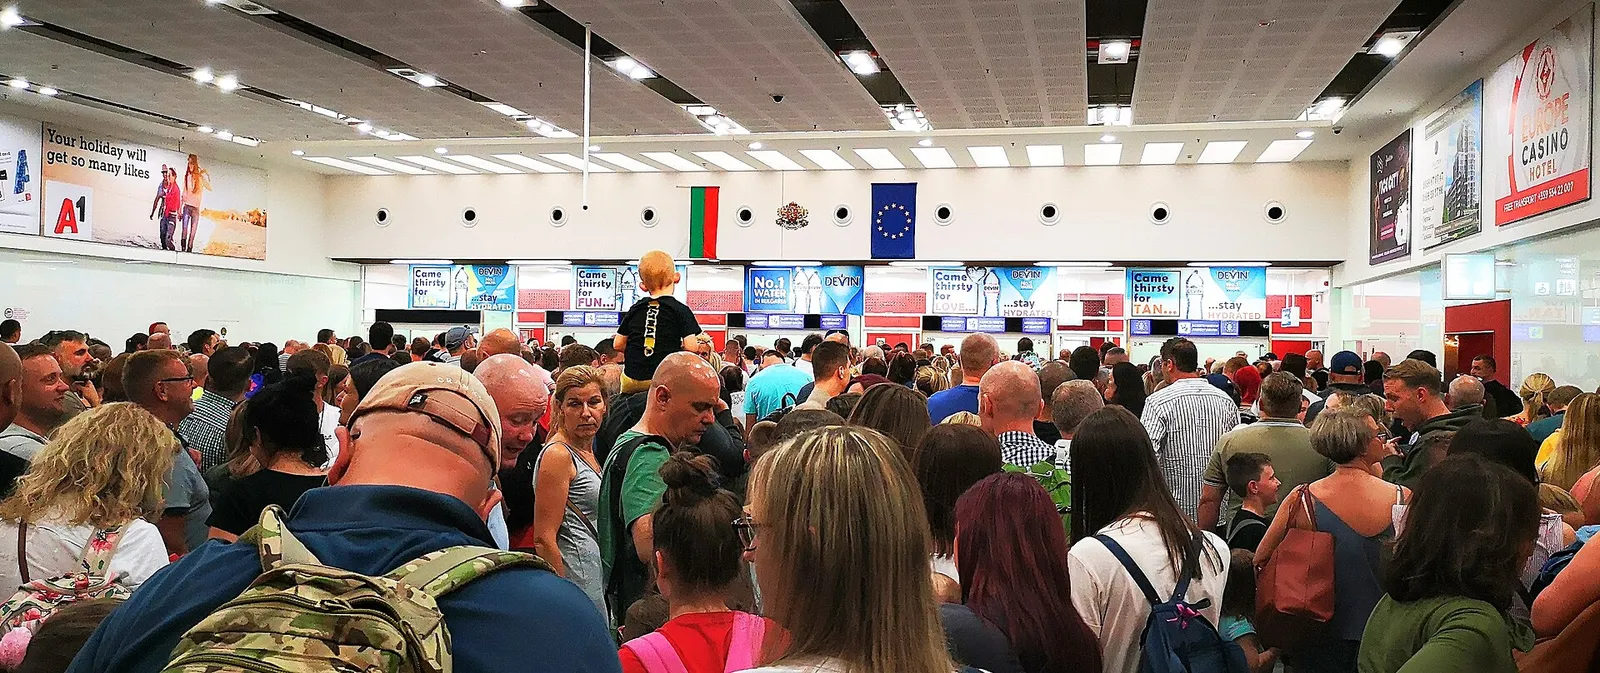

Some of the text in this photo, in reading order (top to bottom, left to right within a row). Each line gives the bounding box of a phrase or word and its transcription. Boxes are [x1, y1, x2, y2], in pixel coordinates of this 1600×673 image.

[1522, 93, 1570, 143] EUROPE
[47, 128, 147, 162] Your holiday will
[1522, 128, 1568, 166] CASINO
[47, 150, 150, 179] get so many likes
[1529, 159, 1557, 181] HOTEL
[54, 195, 86, 234] A1
[415, 269, 442, 278] Came
[578, 270, 607, 279] Came
[935, 271, 967, 282] Came
[1012, 269, 1041, 279] DEVIN
[1134, 273, 1169, 283] Came
[1217, 270, 1249, 280] DEVIN
[415, 278, 446, 288] thirsty
[578, 279, 612, 289] thirsty
[754, 276, 785, 289] No.1
[824, 275, 861, 287] DEVIN
[415, 287, 428, 296] for
[935, 281, 973, 292] thirsty
[1134, 283, 1175, 294] thirsty
[578, 288, 593, 297] for
[754, 288, 787, 298] WATER
[935, 291, 951, 300] for
[577, 298, 614, 307] FUN...
[1133, 293, 1151, 303] for
[935, 302, 976, 311] LOVE...
[1003, 299, 1035, 310] ...stay
[1133, 304, 1177, 315] TAN...
[1208, 301, 1242, 312] ...stay
[1003, 309, 1053, 317] HYDRATED
[1208, 311, 1261, 320] HYDRATED
